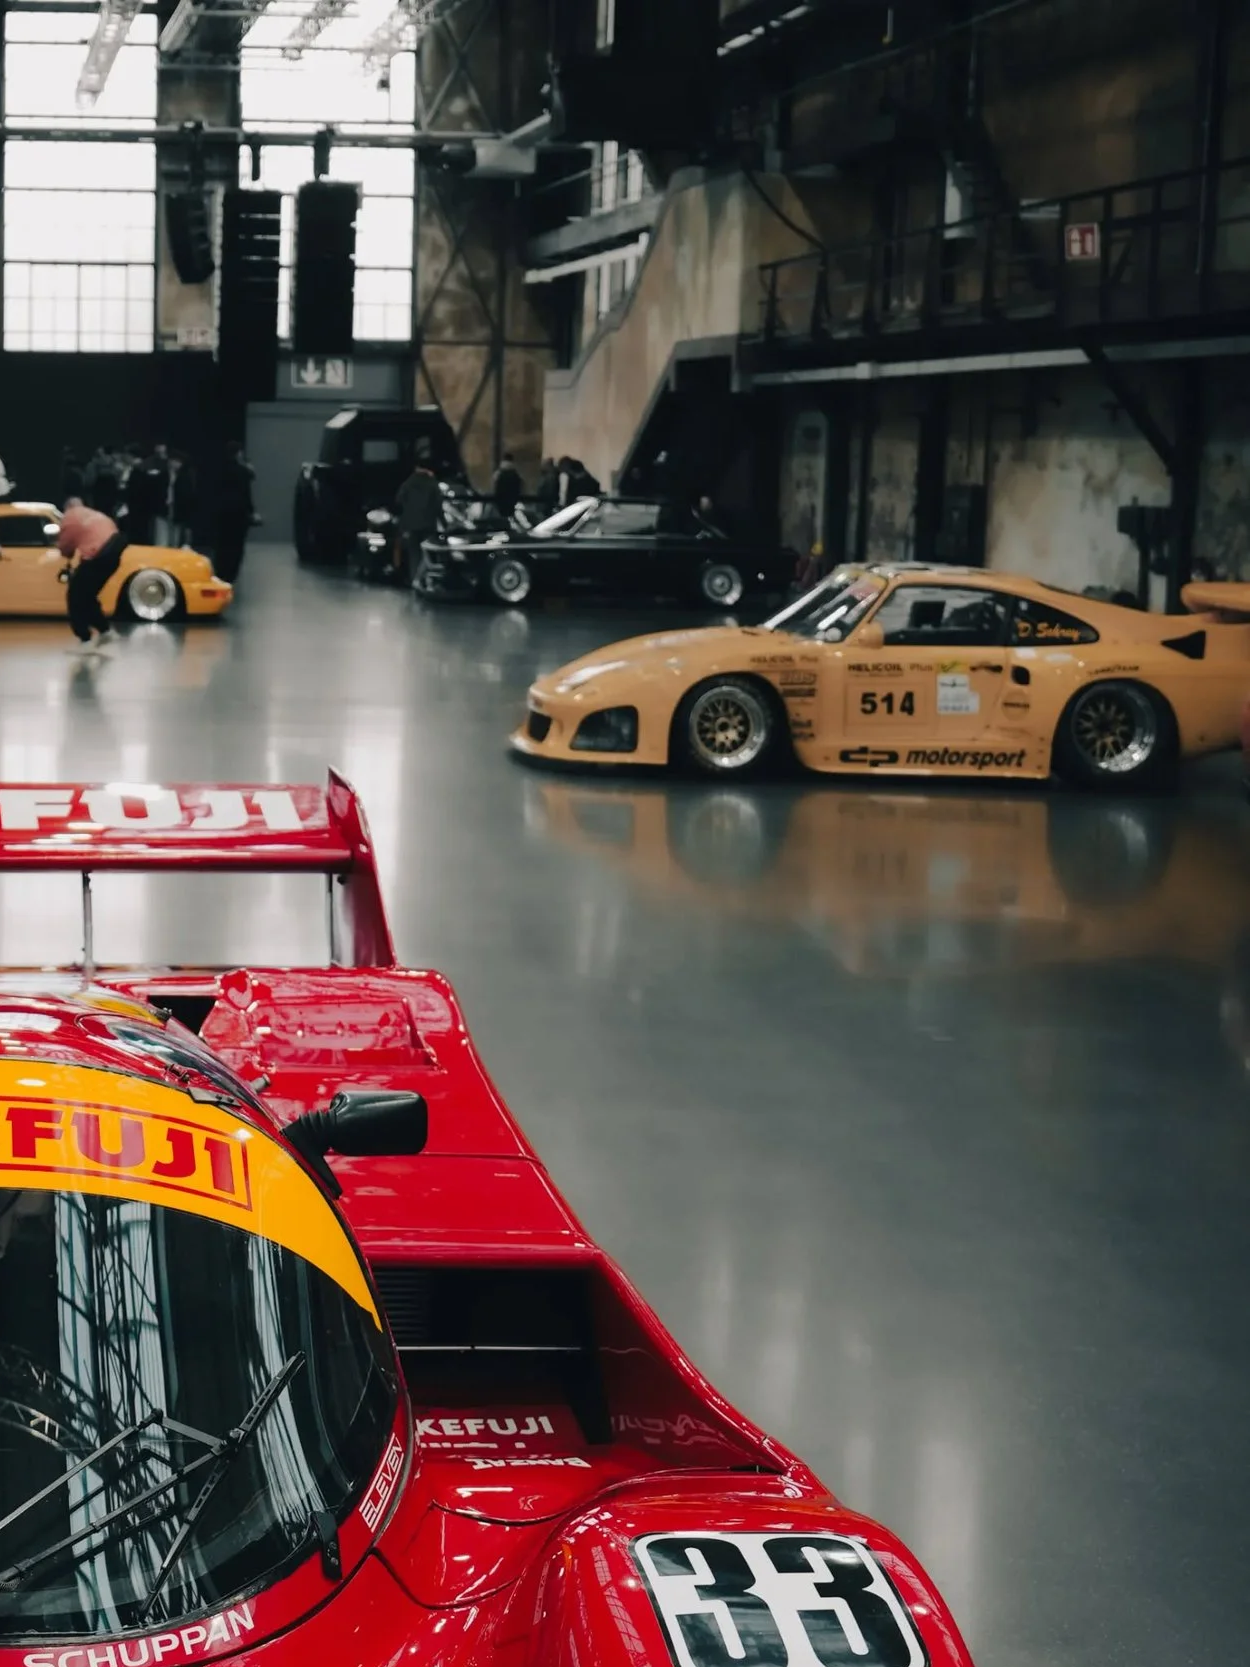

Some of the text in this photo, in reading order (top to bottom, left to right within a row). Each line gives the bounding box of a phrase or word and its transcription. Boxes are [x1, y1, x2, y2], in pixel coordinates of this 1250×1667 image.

[848, 663, 933, 671] HELICOIL Plus
[860, 691, 915, 716] 514
[906, 747, 1027, 770] motorsport
[361, 1436, 403, 1529] ELEVEN
